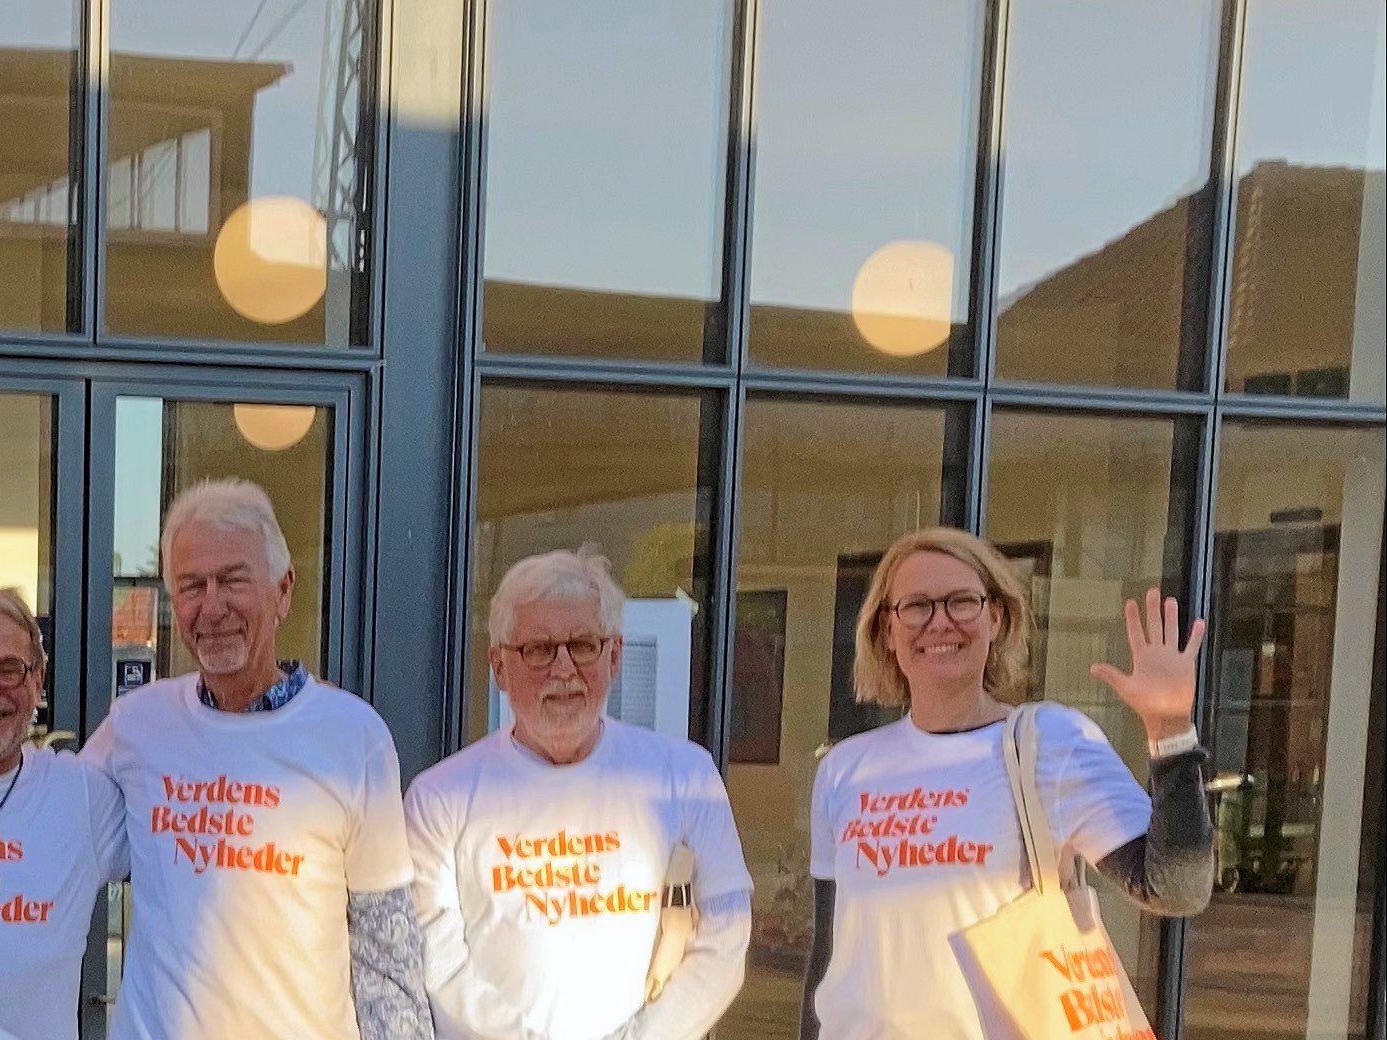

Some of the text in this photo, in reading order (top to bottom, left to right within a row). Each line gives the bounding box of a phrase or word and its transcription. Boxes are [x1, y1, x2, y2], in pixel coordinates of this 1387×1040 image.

[163, 774, 281, 807] Verdens
[860, 787, 970, 814] Verdens
[151, 806, 255, 835] Bedste
[842, 813, 938, 842] Bedste
[174, 836, 305, 875] Nyheder
[497, 829, 620, 860] Verdens
[856, 835, 994, 876] Nyheder
[492, 861, 601, 892] Bedste
[525, 884, 658, 926] Nyheder
